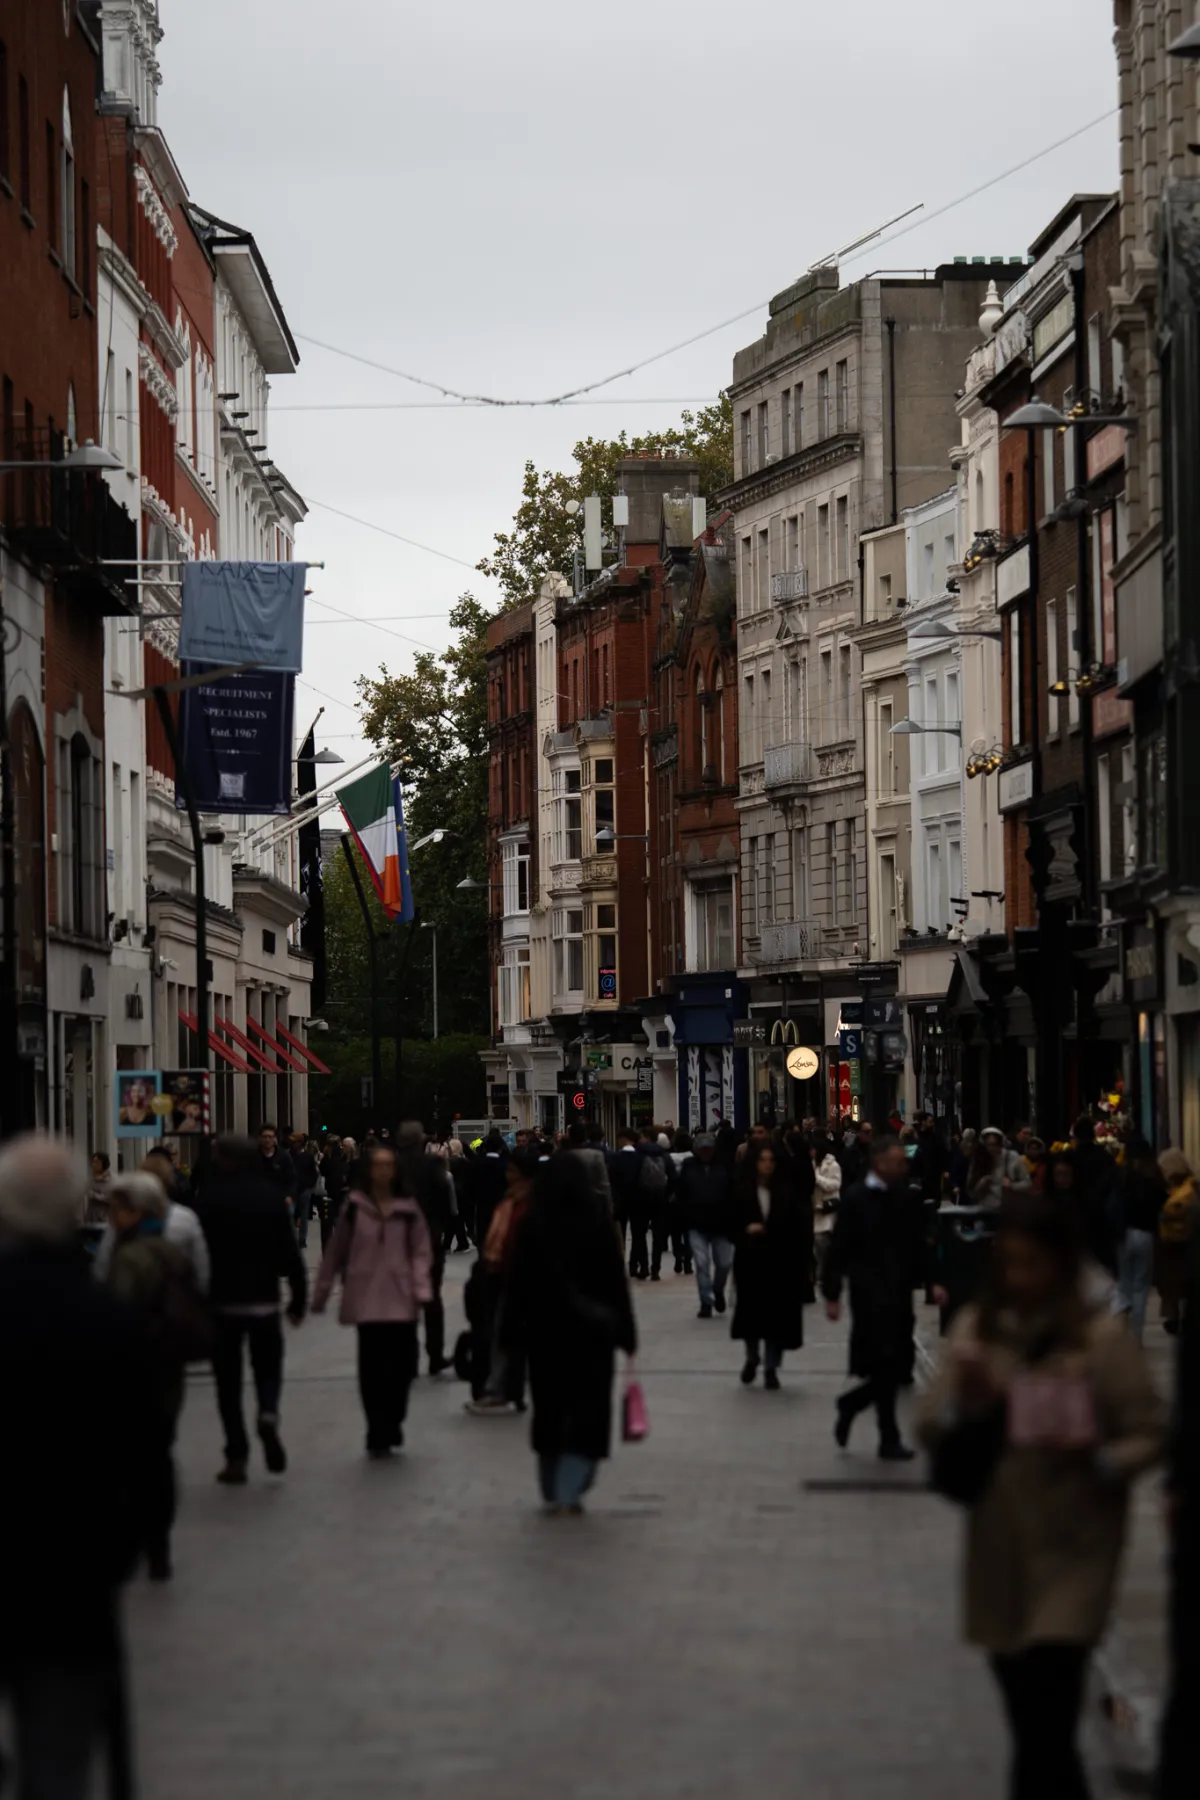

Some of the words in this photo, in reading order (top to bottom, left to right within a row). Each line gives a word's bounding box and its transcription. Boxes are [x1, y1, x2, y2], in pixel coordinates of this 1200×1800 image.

[198, 686, 274, 700] RECRUITMENT
[202, 707, 268, 720] SPECIALISTS
[210, 727, 232, 738] Estd.
[234, 728, 258, 739] 1967
